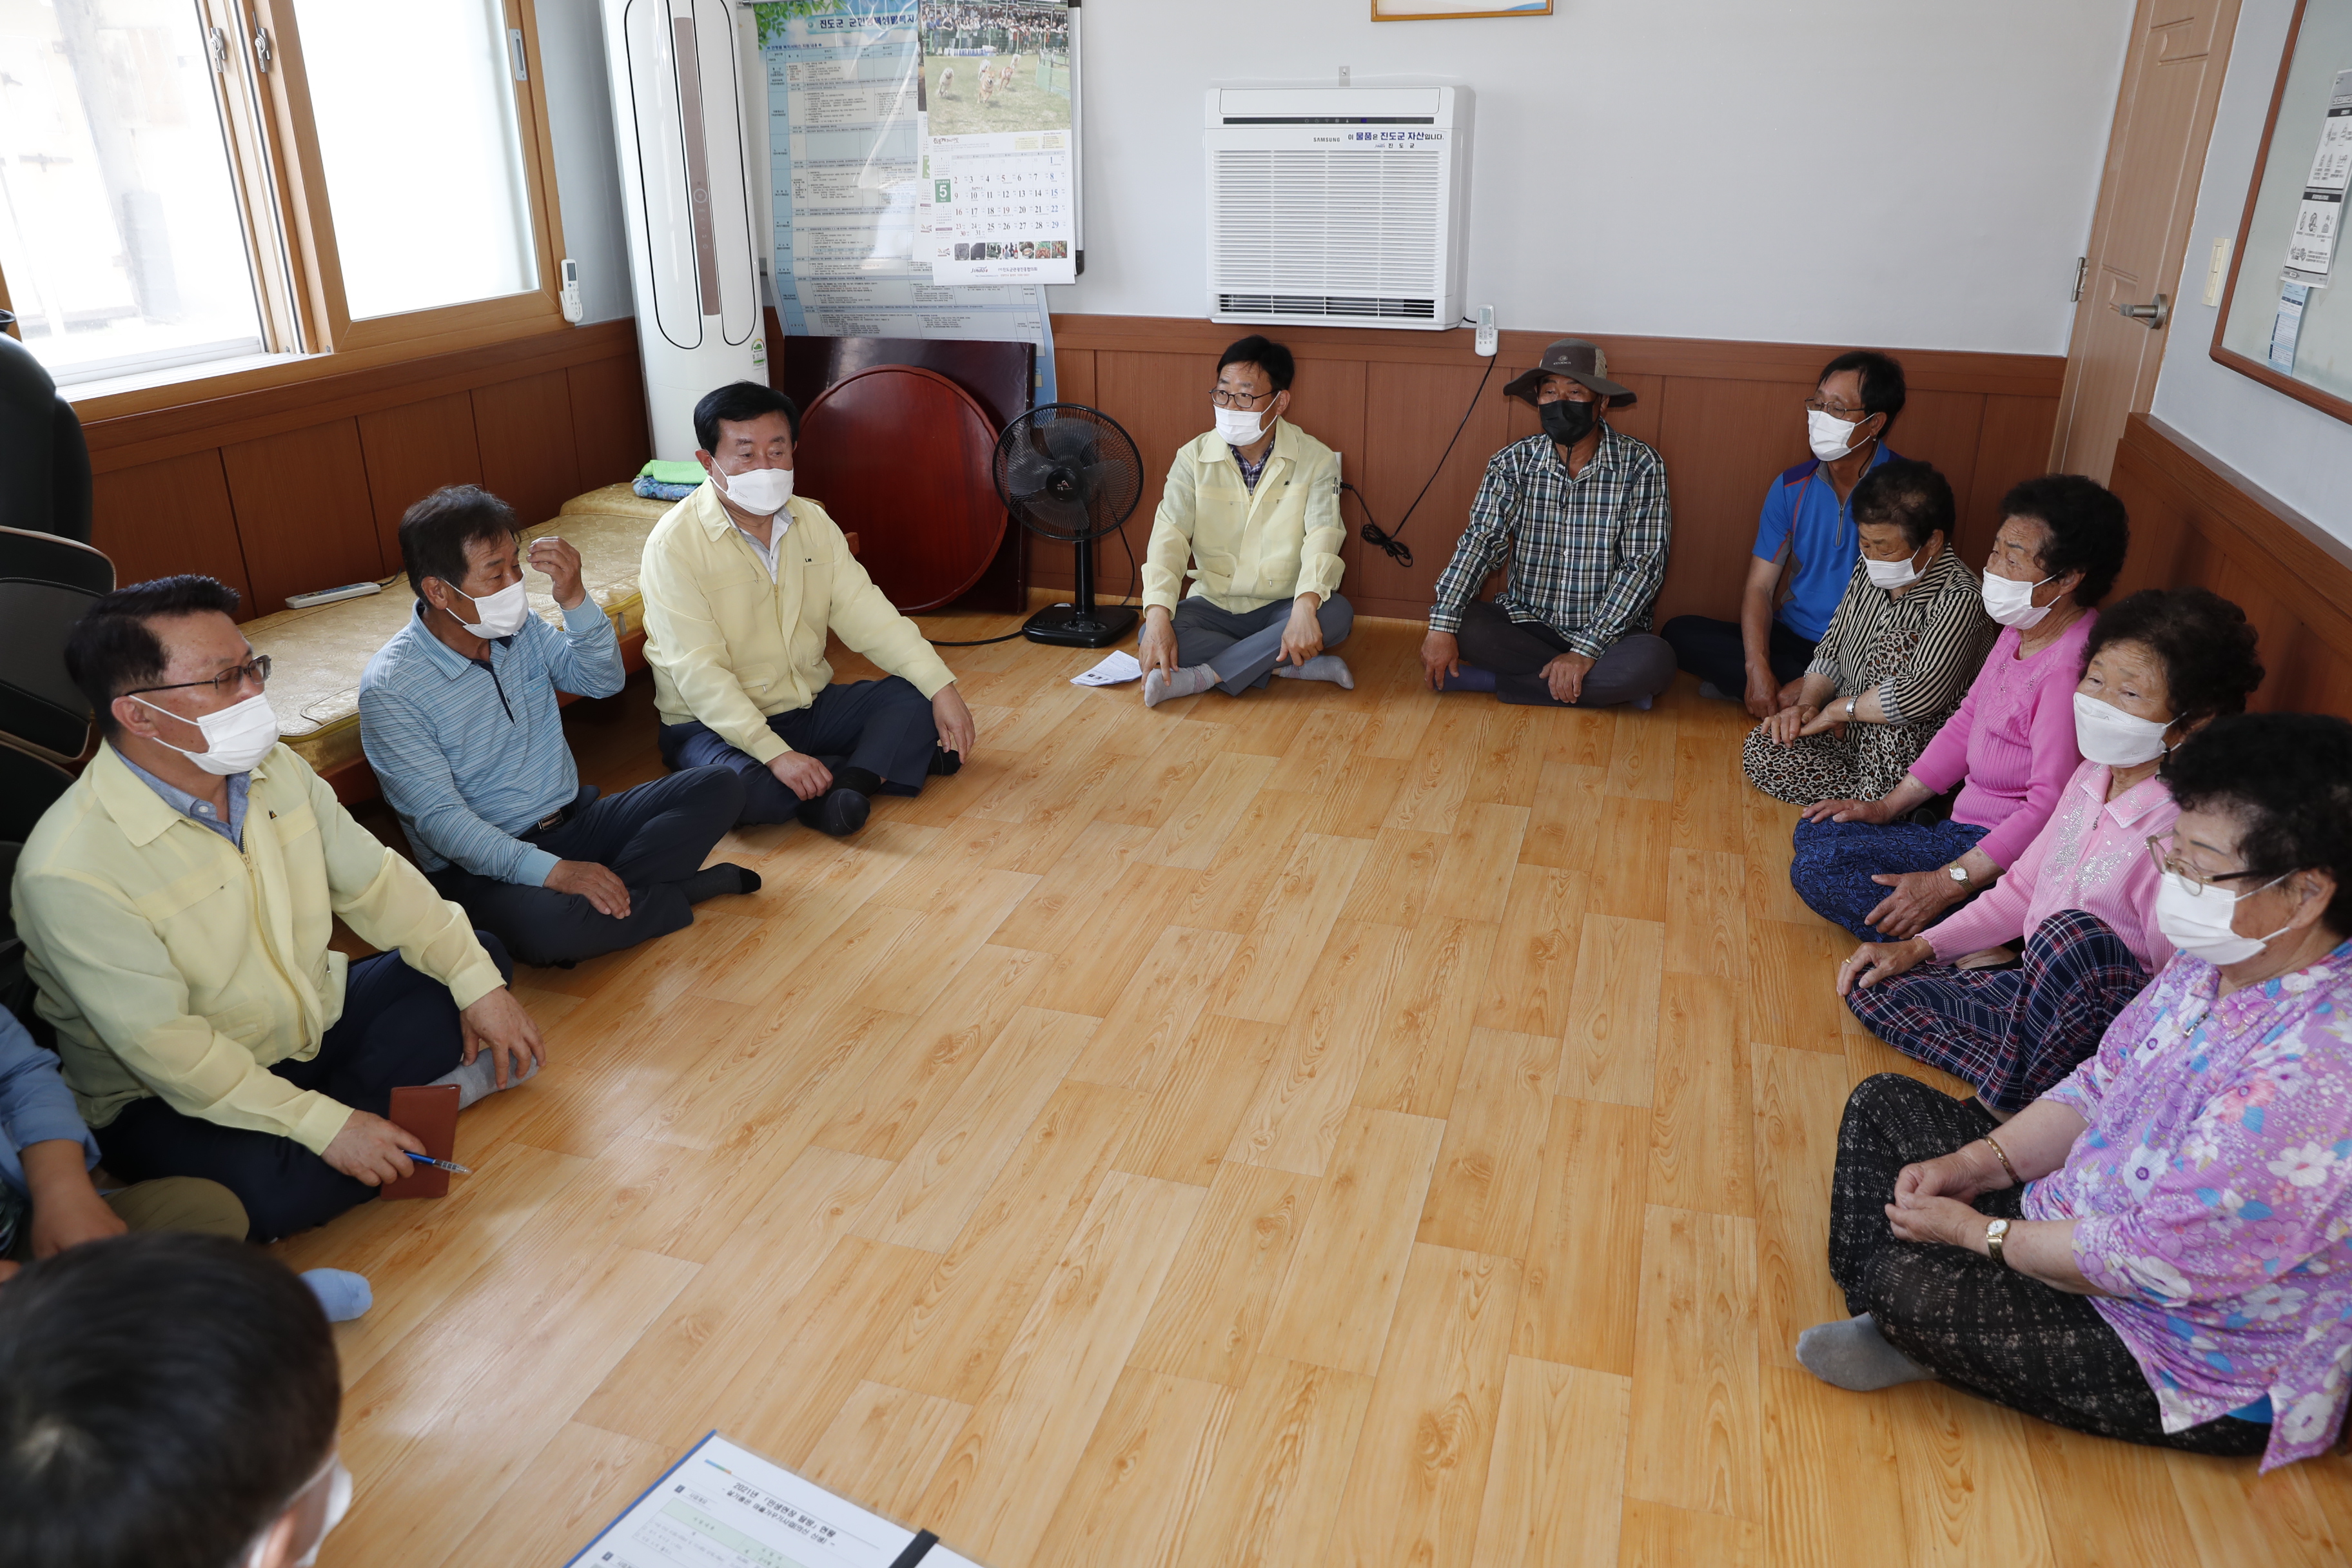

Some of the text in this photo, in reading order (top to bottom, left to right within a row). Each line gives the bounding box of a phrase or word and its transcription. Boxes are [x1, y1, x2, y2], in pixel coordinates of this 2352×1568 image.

[819, 19, 844, 29] 진도군
[1356, 132, 1378, 141] 물품은
[1380, 132, 1406, 141] 진도군
[1407, 132, 1444, 141] 자산입니다.
[939, 184, 948, 198] 5
[733, 1482, 760, 1498] 2021년
